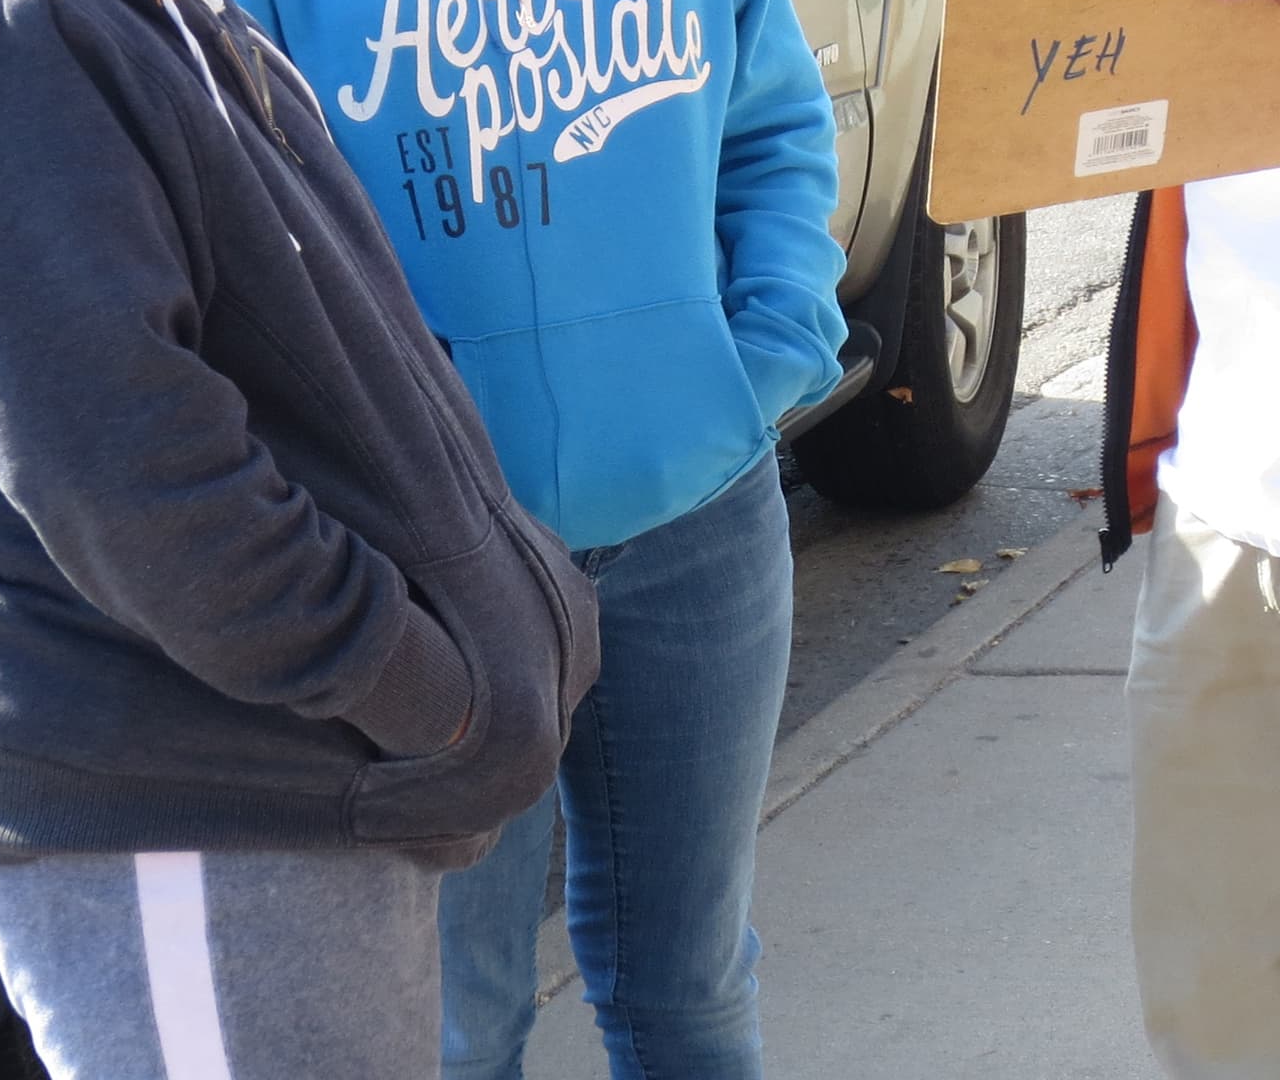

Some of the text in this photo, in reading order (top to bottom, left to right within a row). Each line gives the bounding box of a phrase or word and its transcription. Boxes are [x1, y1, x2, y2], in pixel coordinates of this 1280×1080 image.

[1020, 26, 1127, 116] YEH
[395, 125, 456, 175] EST
[568, 105, 612, 152] NYC
